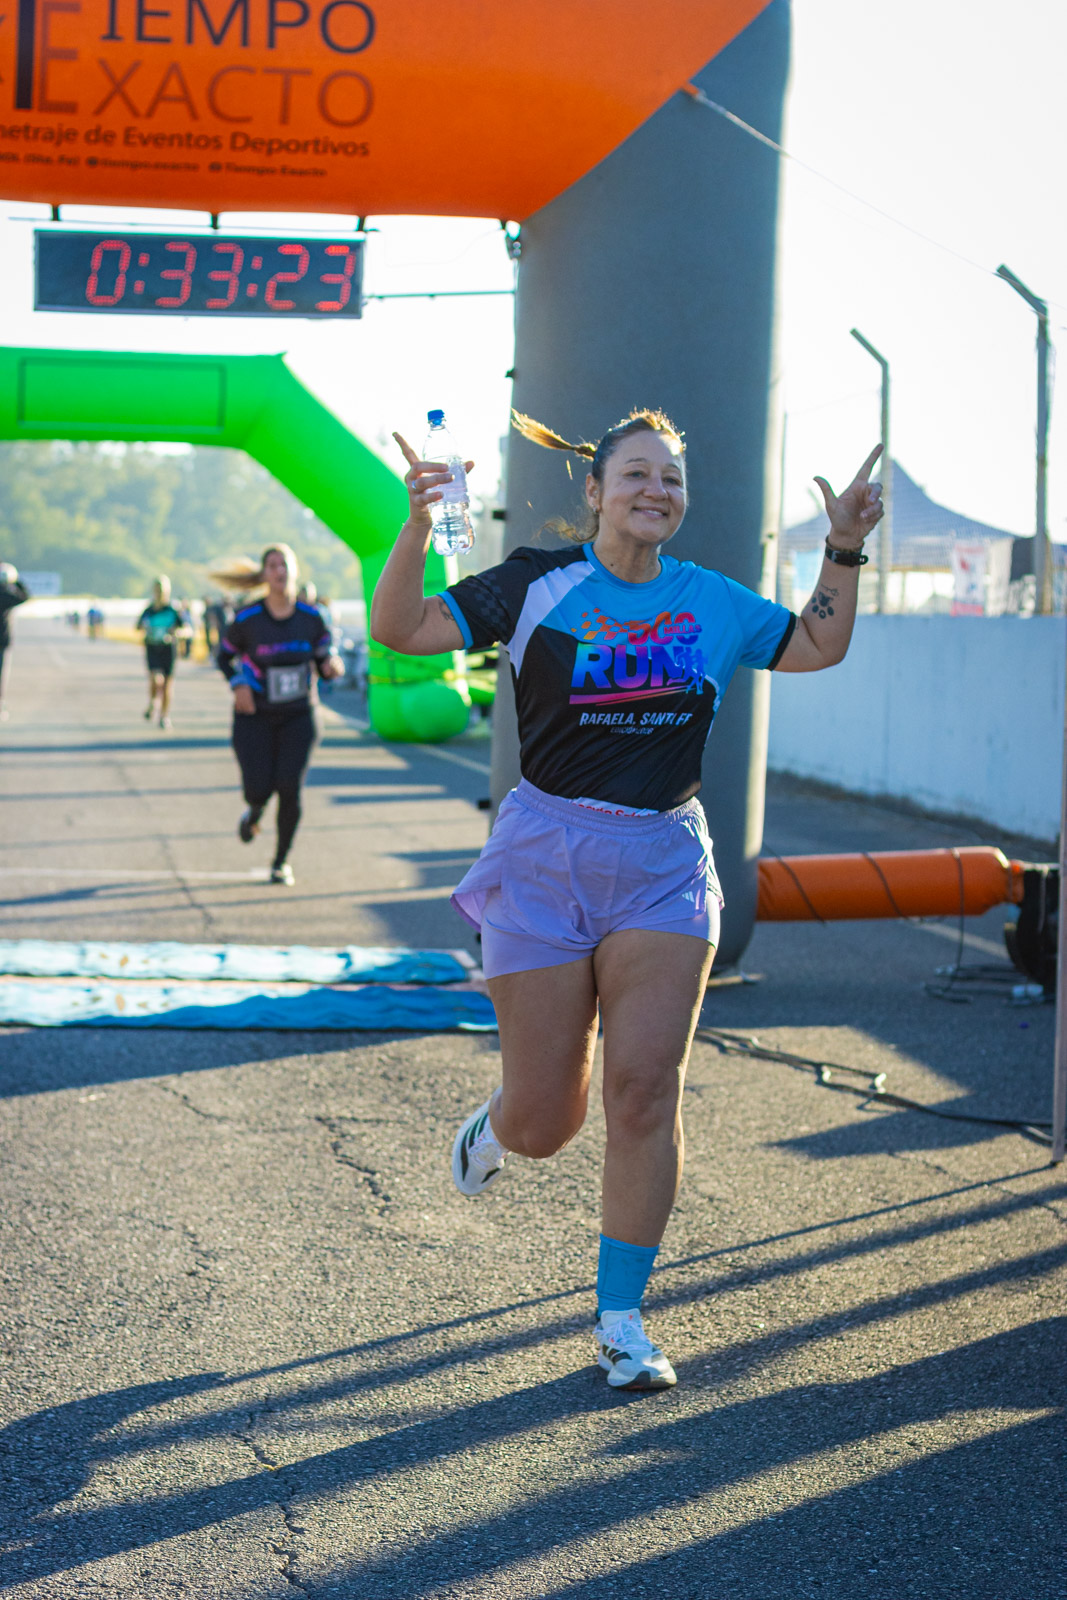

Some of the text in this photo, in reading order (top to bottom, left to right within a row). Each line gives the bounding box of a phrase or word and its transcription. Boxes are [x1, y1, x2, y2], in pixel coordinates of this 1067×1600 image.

[84, 124, 117, 146] de
[123, 126, 223, 151] Eventos
[230, 131, 370, 157] Deportivos
[85, 239, 356, 313] 0:33:23
[663, 624, 703, 634] MILLAS
[571, 642, 690, 689] RUN
